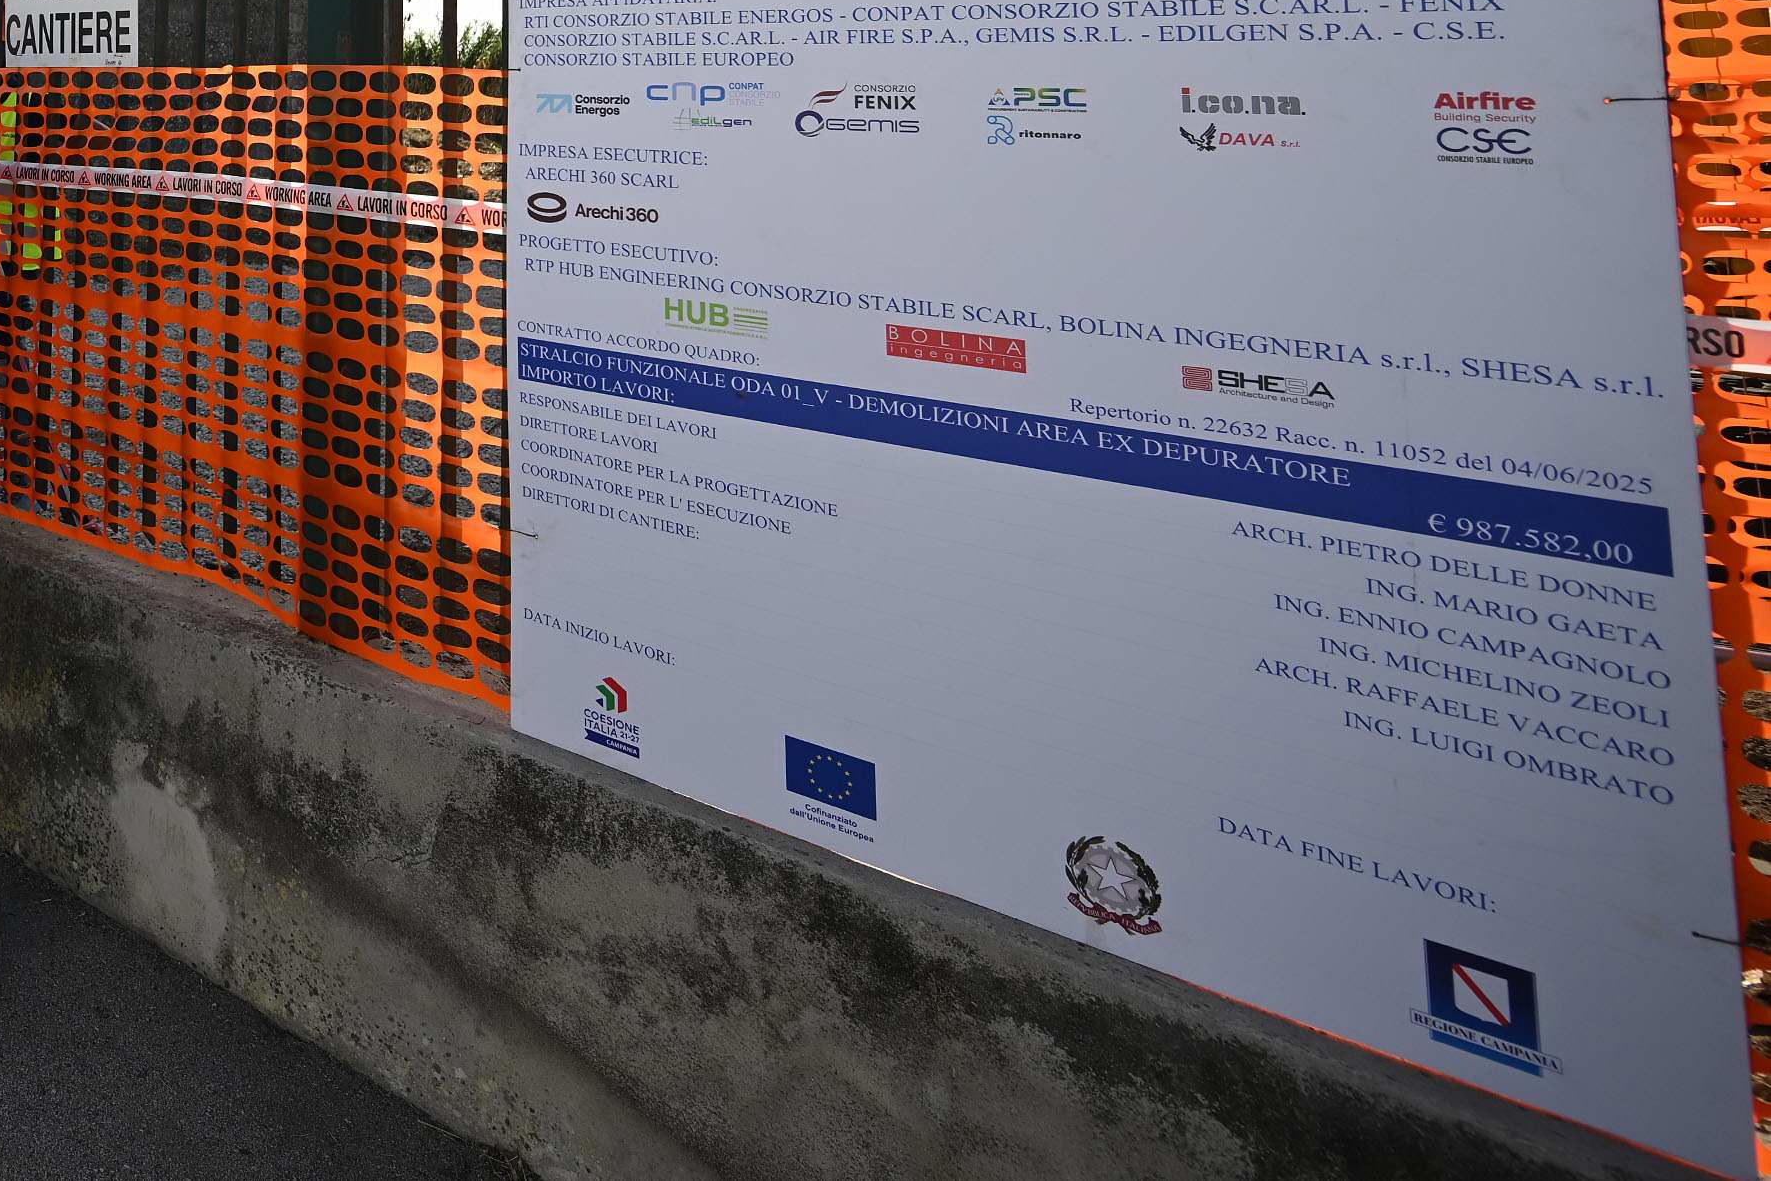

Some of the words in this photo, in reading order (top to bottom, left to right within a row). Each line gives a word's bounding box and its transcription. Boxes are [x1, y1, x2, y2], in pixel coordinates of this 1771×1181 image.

[524, 14, 549, 29] RTI
[552, 11, 650, 28] CONSORZIO
[655, 9, 733, 26] STABILE
[738, 6, 834, 26] ENERGOS
[852, 4, 945, 22] CONPAT
[951, 0, 1099, 21] CONSORZIO
[6, 10, 131, 55] CANTIERE
[523, 32, 617, 48] CONSORZIO
[621, 30, 696, 47] STABILE
[701, 29, 785, 46] S.C.AR.L.
[803, 28, 841, 45] AIR
[846, 27, 896, 45] FIRE
[901, 27, 969, 47] S.P.A.,
[975, 25, 1055, 44] GEMIS
[1063, 25, 1133, 43] S.R.L.
[1158, 22, 1288, 42] EDILGEN
[1298, 22, 1382, 41] S.P.A.
[1413, 20, 1505, 40] C.S.E.
[523, 51, 617, 67] CONSORZIO
[622, 51, 697, 67] STABILE
[702, 50, 795, 67] EUROPEO
[853, 95, 916, 110] FENIX
[1433, 91, 1537, 111] Airfire
[1018, 130, 1082, 140] ritonnaro
[16, 167, 40, 179] LAVORI
[41, 169, 49, 181] IN
[51, 170, 75, 183] CORSO
[94, 173, 130, 188] WORKING
[132, 177, 152, 189] AREA
[172, 178, 201, 192] LAVORI
[204, 179, 213, 193] IN
[215, 181, 242, 196] CORSO
[265, 185, 306, 204] WORKING
[308, 192, 332, 207] AREA
[357, 196, 392, 215] LAVORI
[396, 200, 407, 216] IN
[410, 202, 448, 221] CORSO
[524, 256, 555, 274] RTP
[559, 260, 594, 278] HUB
[599, 264, 725, 294] ENGINEERING
[730, 279, 852, 308] CONSORZIO
[858, 292, 956, 320] STABILE
[962, 303, 1052, 333] SCARL,
[1059, 313, 1166, 343] BOLINA
[1174, 326, 1371, 366] INGEGNERIA
[1380, 352, 1451, 378] s.r.l.,
[1461, 356, 1582, 389] SHESA
[1594, 375, 1664, 398] s.r.l.
[664, 297, 729, 327] HUB
[519, 362, 597, 390] IMPORTO
[601, 376, 675, 404] LAVORI:
[1218, 370, 1335, 400] SHESA
[518, 340, 603, 369] STRALCIO
[606, 355, 727, 391] FUNZIONALE
[730, 372, 777, 397] ODA
[781, 382, 830, 408] 01_V
[848, 392, 1009, 434] DEMOLIZIONI
[1016, 419, 1089, 446] AREA
[1098, 430, 1135, 454] EX
[1143, 437, 1351, 487] DEPURATORE
[1427, 512, 1446, 538] €
[1456, 516, 1634, 565] 987.582,00
[1231, 519, 1313, 549] ARCH.
[1320, 534, 1422, 568] PIETRO
[1429, 553, 1529, 588] DELLE
[1538, 573, 1657, 612] DONNE
[1365, 576, 1425, 605] ING.
[1433, 589, 1539, 626] MARIO
[1547, 612, 1663, 651] GAETA
[523, 606, 562, 631] DATA
[565, 619, 610, 645] INIZIO
[613, 634, 675, 666] LAVORI:
[1274, 592, 1330, 620] ING.
[1337, 605, 1429, 640] ENNIO
[1437, 626, 1672, 689] CAMPAGNOLO
[1319, 635, 1376, 664] ING.
[1384, 649, 1561, 704] MICHELINO
[1570, 689, 1670, 729] ZEOLI
[584, 709, 640, 736] COESIONE
[1254, 656, 1338, 690] ARCH.
[1345, 675, 1499, 727] RAFFAELE
[1507, 712, 1675, 766] VACCARO
[584, 718, 617, 738] ITALIA
[620, 730, 640, 743] 21-27
[1344, 709, 1402, 740] ING.
[1411, 725, 1494, 763] LUIGI
[1503, 749, 1674, 805] OMBRATO
